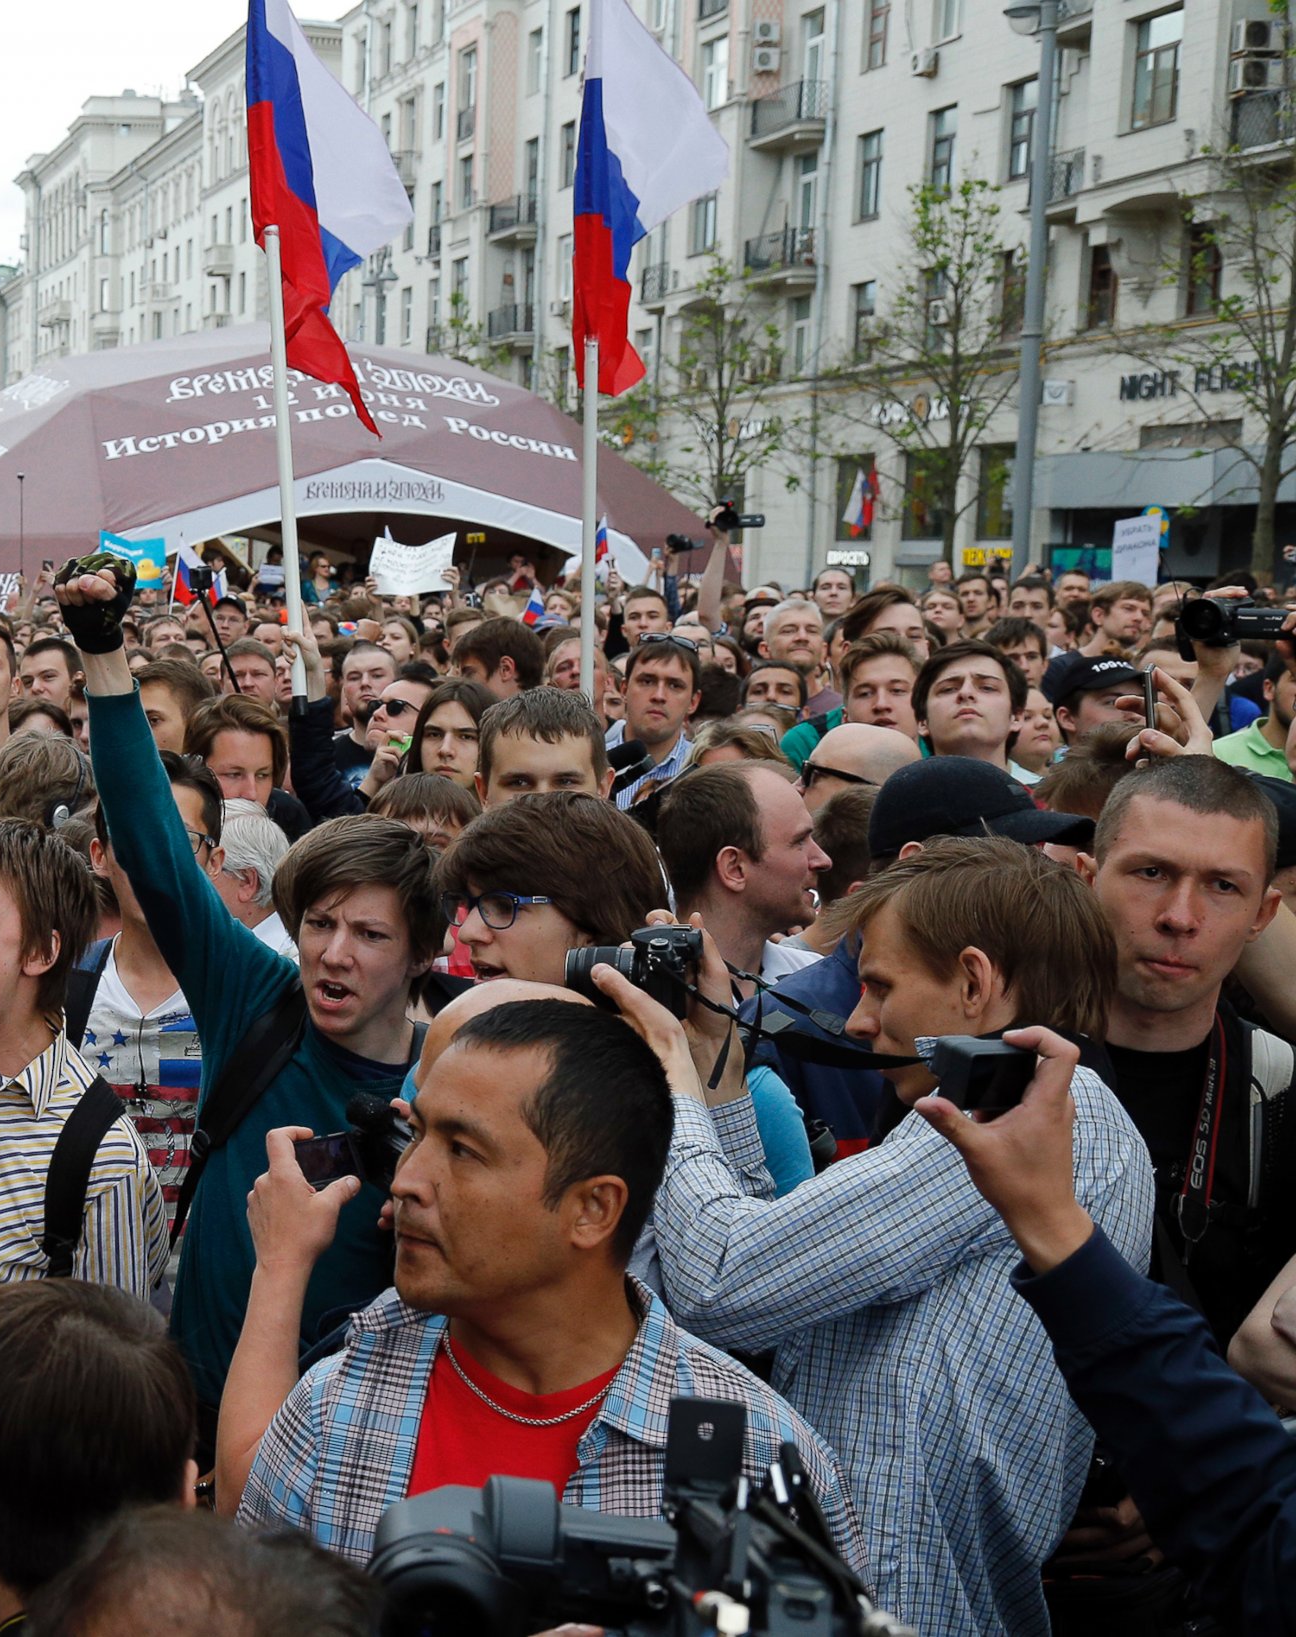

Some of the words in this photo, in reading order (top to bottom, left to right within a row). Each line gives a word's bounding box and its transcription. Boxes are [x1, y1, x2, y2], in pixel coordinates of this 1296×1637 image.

[1120, 370, 1180, 401] NIGHT
[1195, 360, 1267, 394] FLIGH
[103, 414, 277, 461] История
[443, 415, 579, 462] России
[1190, 1138, 1208, 1190] EOS
